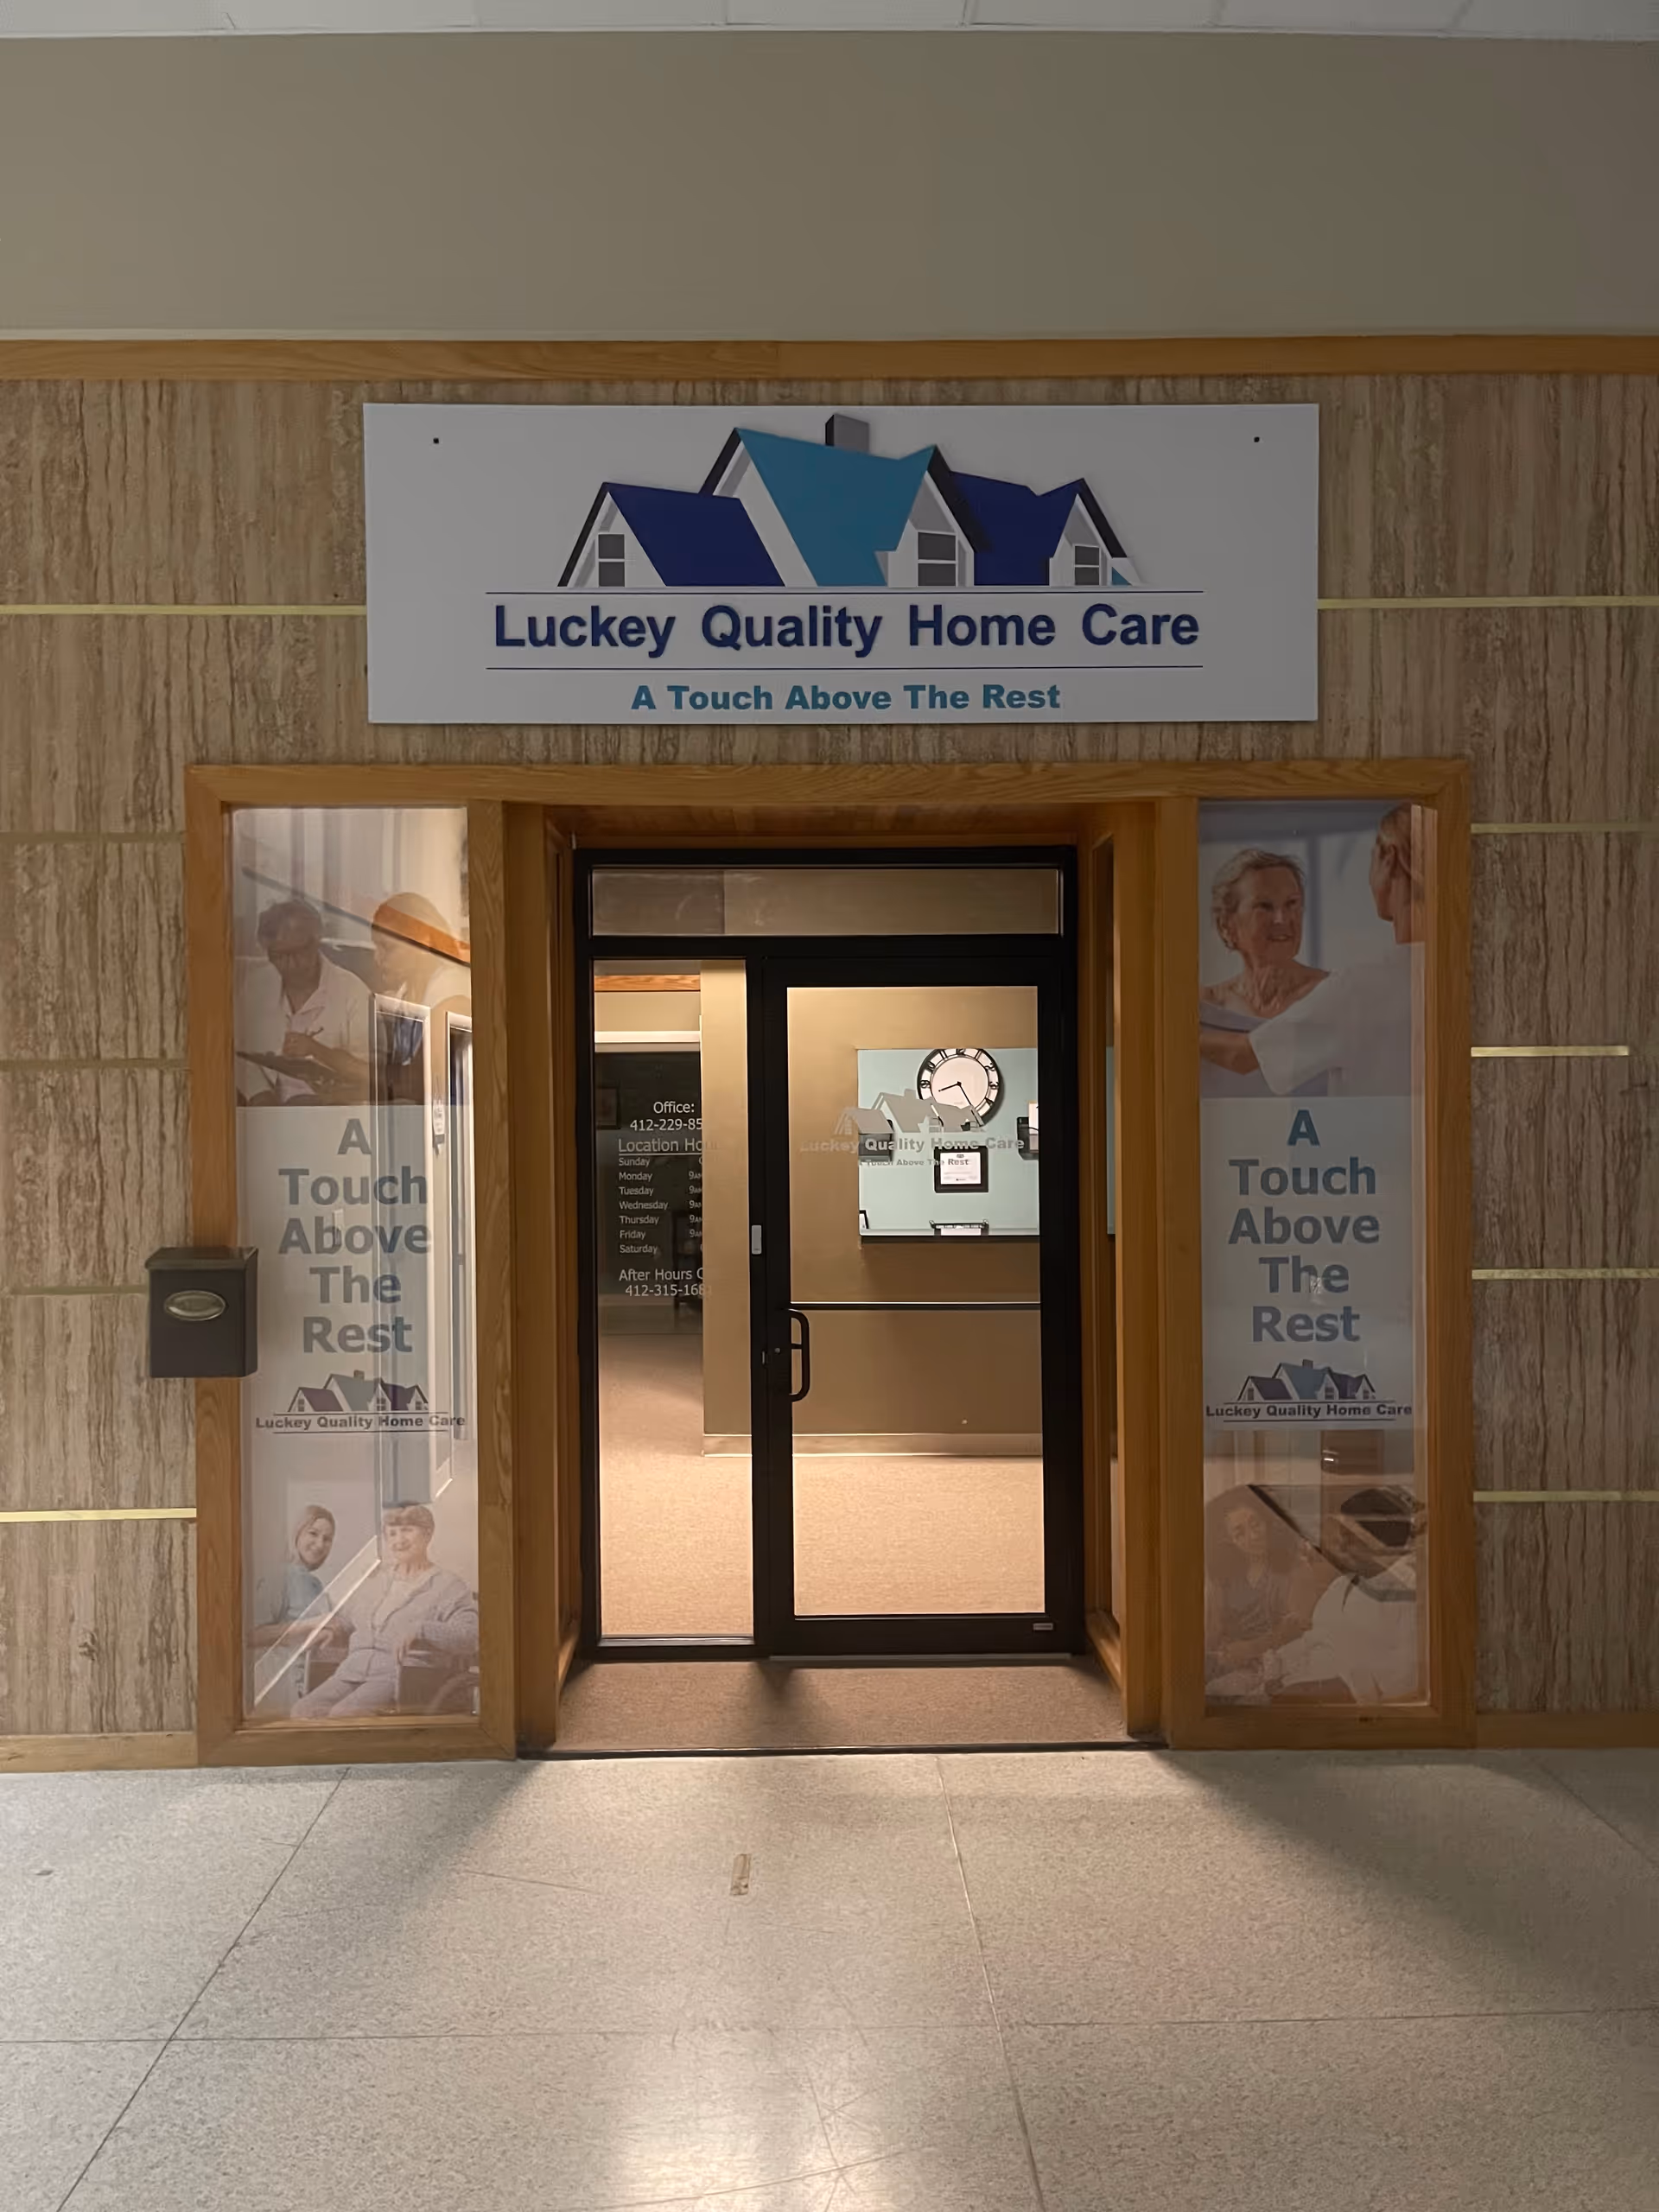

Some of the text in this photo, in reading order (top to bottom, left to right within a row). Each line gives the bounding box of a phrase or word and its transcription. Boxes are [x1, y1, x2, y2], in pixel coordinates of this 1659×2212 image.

[495, 602, 1200, 659] Luckey Quality Home Care
[631, 683, 1061, 710] A Touch Above The Rest
[652, 1101, 696, 1115] Office:
[629, 1118, 702, 1132] 412-229-85
[1287, 1109, 1321, 1147] A
[337, 1118, 372, 1155] A
[800, 1136, 1026, 1154] Luckey Quality Home Care
[618, 1138, 679, 1153] Location
[618, 1157, 650, 1167] Sunday
[947, 1158, 969, 1166] Rest
[618, 1172, 653, 1182] Monday
[1228, 1156, 1376, 1196] Touch
[278, 1166, 429, 1205] Touch
[619, 1186, 654, 1197] Tuesday
[619, 1200, 669, 1211] Wednesday
[619, 1215, 660, 1225] Thursday
[1228, 1206, 1380, 1245] Above
[278, 1216, 432, 1255] Above
[619, 1230, 646, 1240] Friday
[619, 1244, 658, 1255] Saturday
[619, 1268, 651, 1281] After
[654, 1268, 692, 1281] Hours
[1258, 1255, 1350, 1294] The
[308, 1265, 402, 1304] The
[1252, 1305, 1361, 1343] Rest
[302, 1316, 413, 1353] Rest
[1205, 1404, 1413, 1419] Luckey Quality Home Care
[256, 1414, 466, 1431] Luckey Quality Home Care
